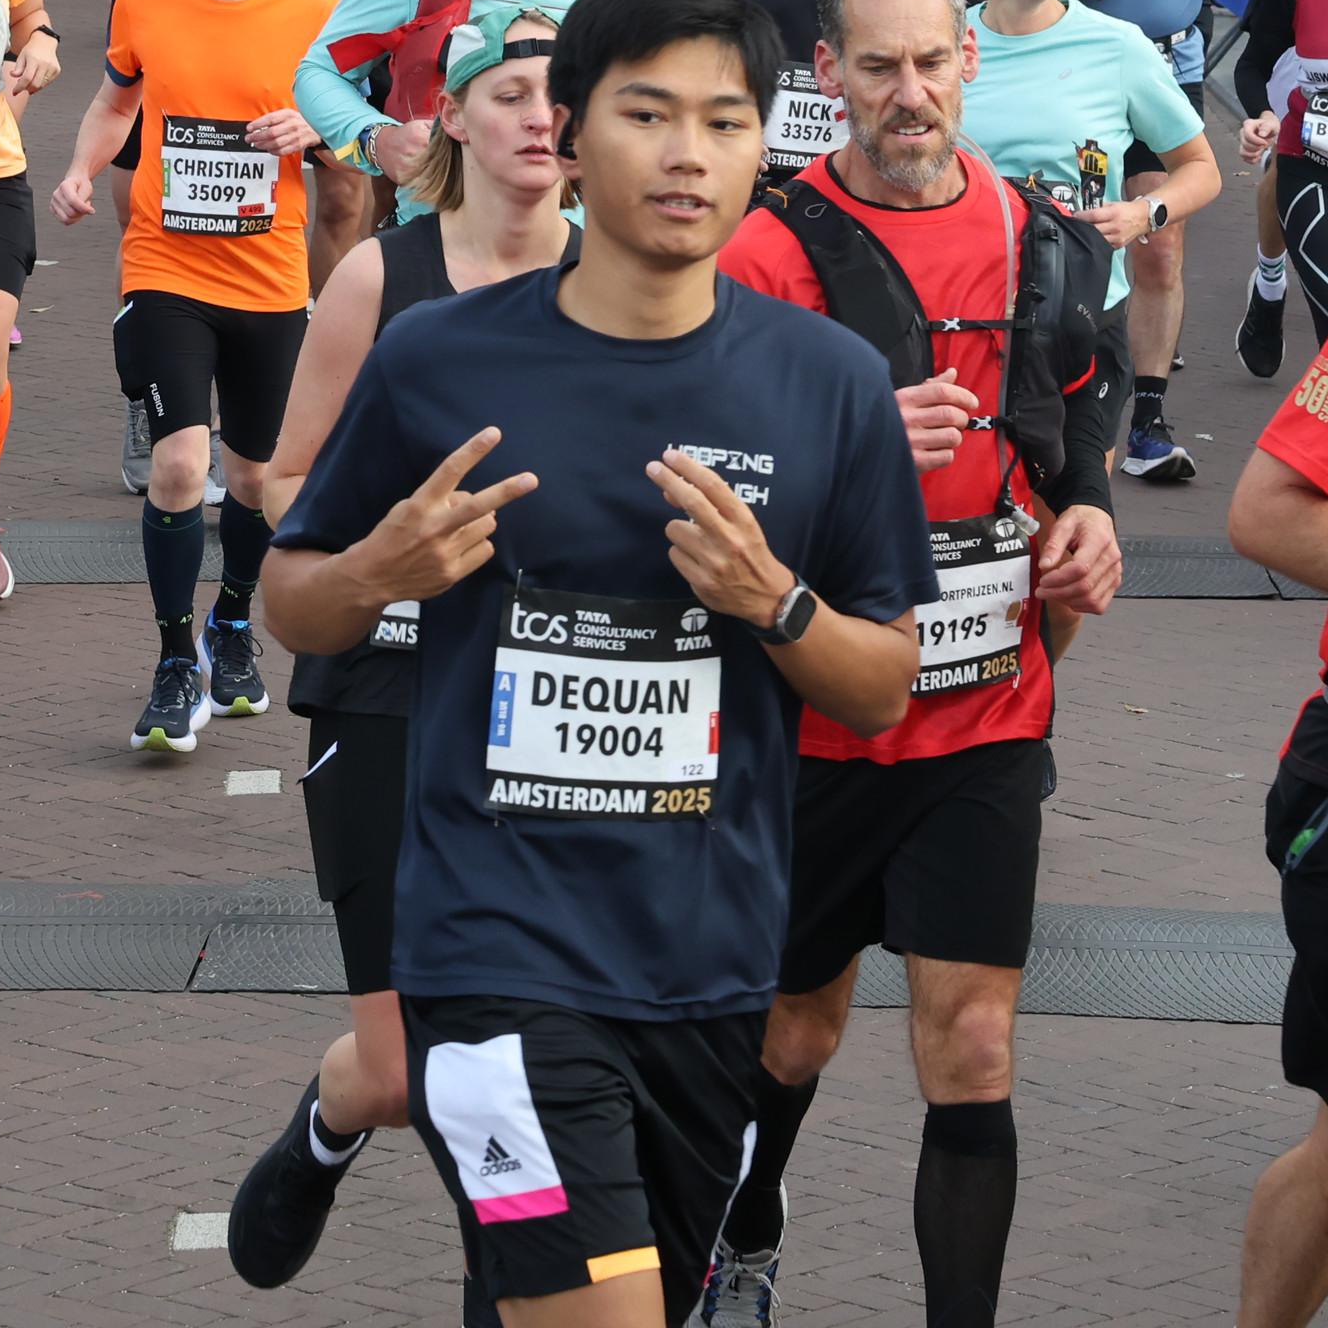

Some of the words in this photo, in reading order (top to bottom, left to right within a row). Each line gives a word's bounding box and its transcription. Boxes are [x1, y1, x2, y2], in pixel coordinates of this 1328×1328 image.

[788, 100, 832, 121] NICK
[166, 123, 194, 144] tcs
[196, 132, 240, 141] CONSULTANCY
[781, 122, 832, 142] 33576
[196, 138, 224, 146] SERVICES
[174, 158, 264, 179] CHRISTIAN
[187, 183, 246, 203] 35099
[163, 214, 237, 232] AMSTERDAM
[239, 219, 270, 232] 2025
[149, 382, 165, 417] FUSION
[929, 532, 950, 541] ATA
[994, 538, 1024, 554] TATA
[932, 551, 962, 562] RVICES
[941, 580, 1014, 602] ORTPRIJZEN.NL
[510, 601, 568, 645] tcs
[576, 610, 612, 624] TATA
[574, 623, 657, 640] CONSULTANCY
[572, 635, 627, 651] SERVICES
[674, 635, 713, 652] TATA
[982, 652, 1017, 679] 2025
[498, 674, 511, 691] A
[531, 670, 691, 715] DEQUAN
[555, 722, 664, 757] 19004
[681, 764, 705, 777] 122
[489, 778, 647, 813] AMSTERDAM
[651, 787, 712, 814] 2025
[480, 1158, 522, 1176] adidas
